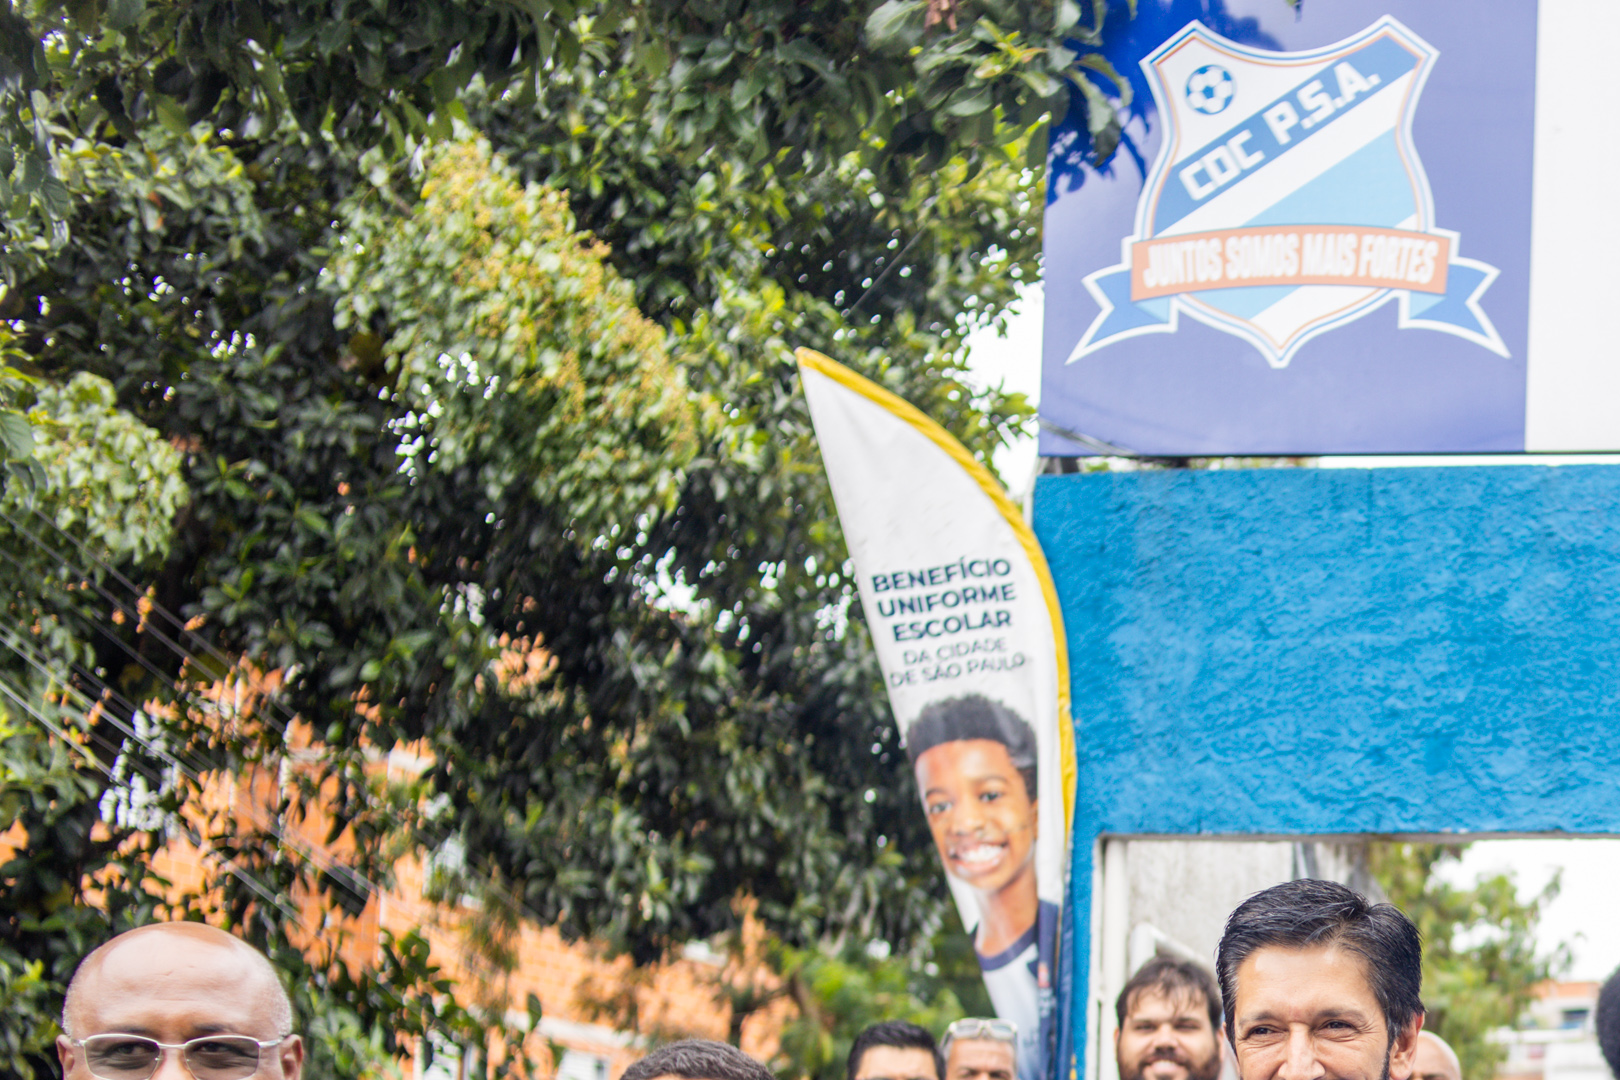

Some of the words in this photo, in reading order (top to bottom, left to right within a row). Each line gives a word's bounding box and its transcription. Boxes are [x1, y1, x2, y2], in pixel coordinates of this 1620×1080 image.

[1179, 129, 1266, 200] CDC
[1262, 61, 1382, 146] P.S.A.
[1143, 238, 1222, 287] JUNTOS
[1225, 233, 1299, 280] SOMOS
[1301, 233, 1357, 277] MAIS
[1357, 233, 1439, 284] FORTES
[871, 556, 1011, 593] BENEFÍCIO
[878, 583, 1016, 617] UNIFORME
[892, 610, 1012, 642] ESCOLAR
[903, 649, 931, 665] DA
[936, 637, 1007, 660] CIDADE
[890, 668, 917, 688] DE
[967, 652, 1026, 674] PAULO
